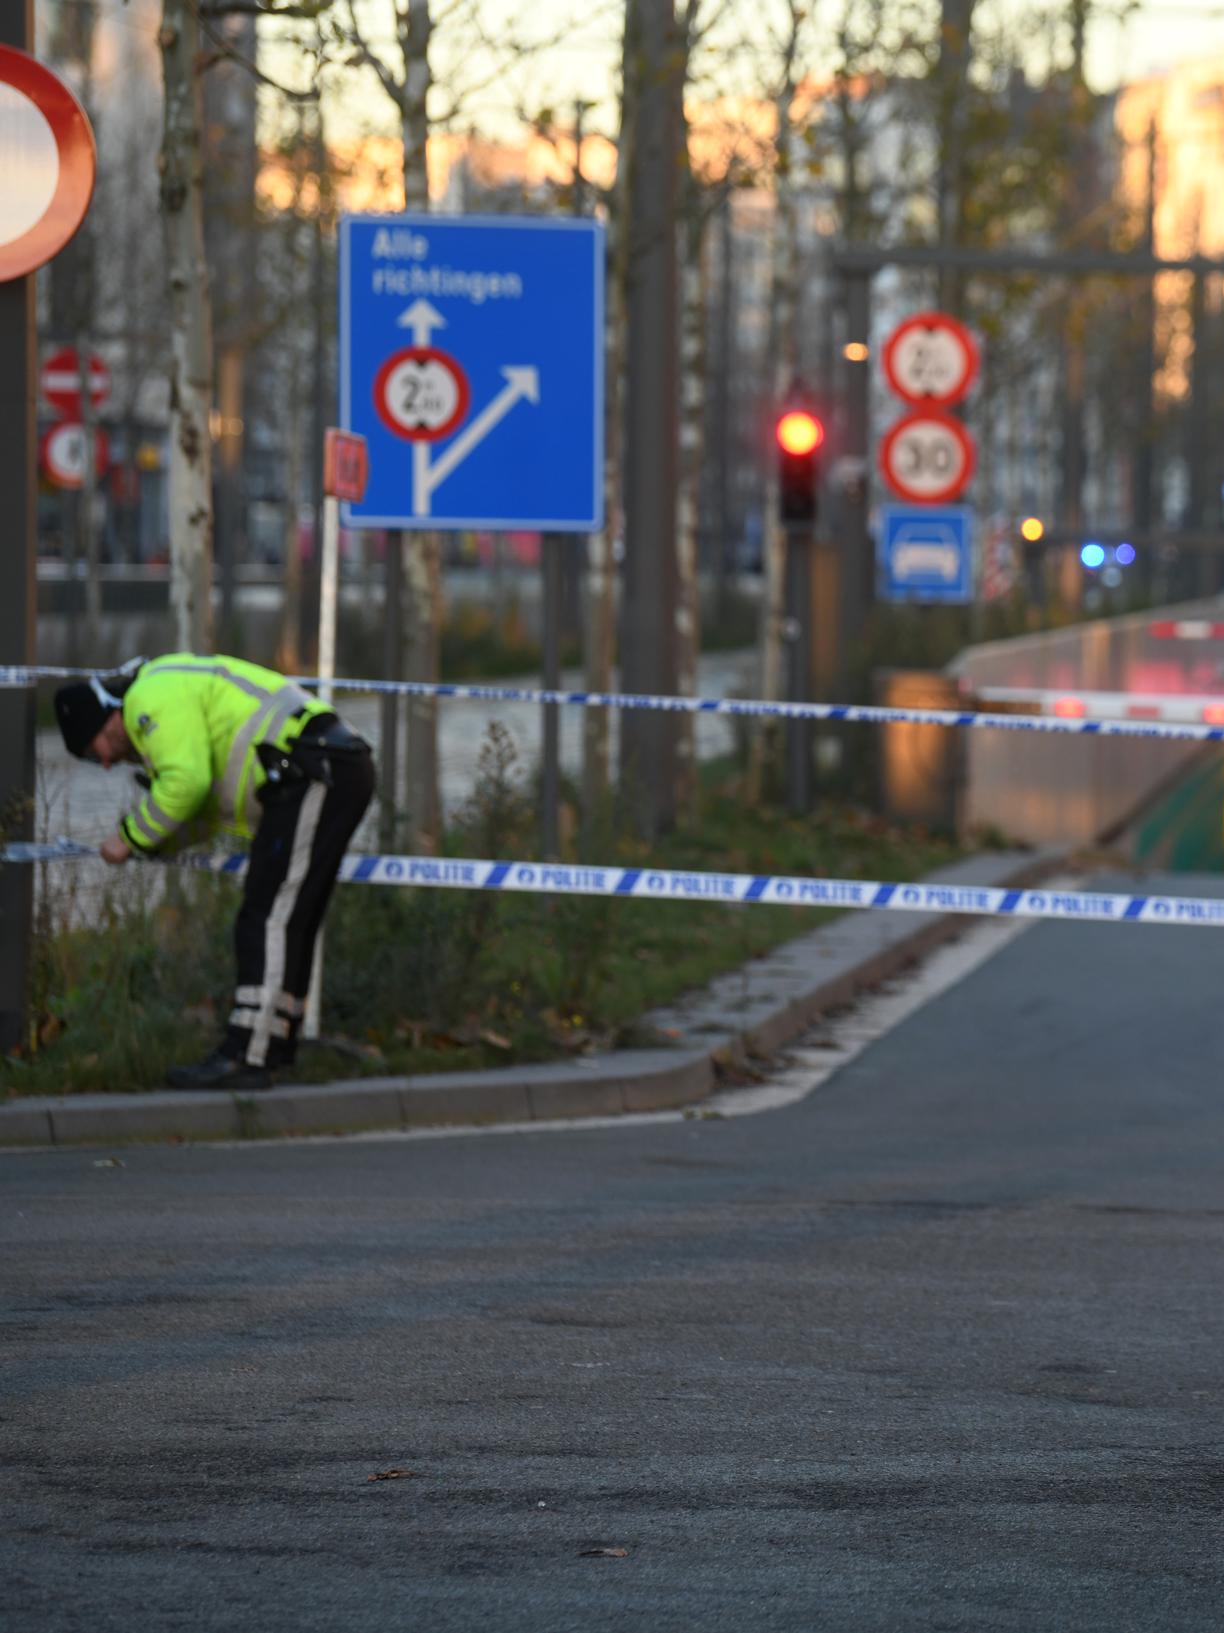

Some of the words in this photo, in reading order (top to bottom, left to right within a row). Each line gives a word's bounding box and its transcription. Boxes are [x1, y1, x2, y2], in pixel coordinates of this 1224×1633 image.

[372, 227, 428, 261] Alle
[372, 263, 523, 304] richtingen
[903, 437, 957, 479] 30
[409, 858, 475, 882] POLITIE
[541, 866, 606, 889] POLITIE
[671, 876, 736, 895] POLITIE
[800, 881, 863, 902] POLITIE
